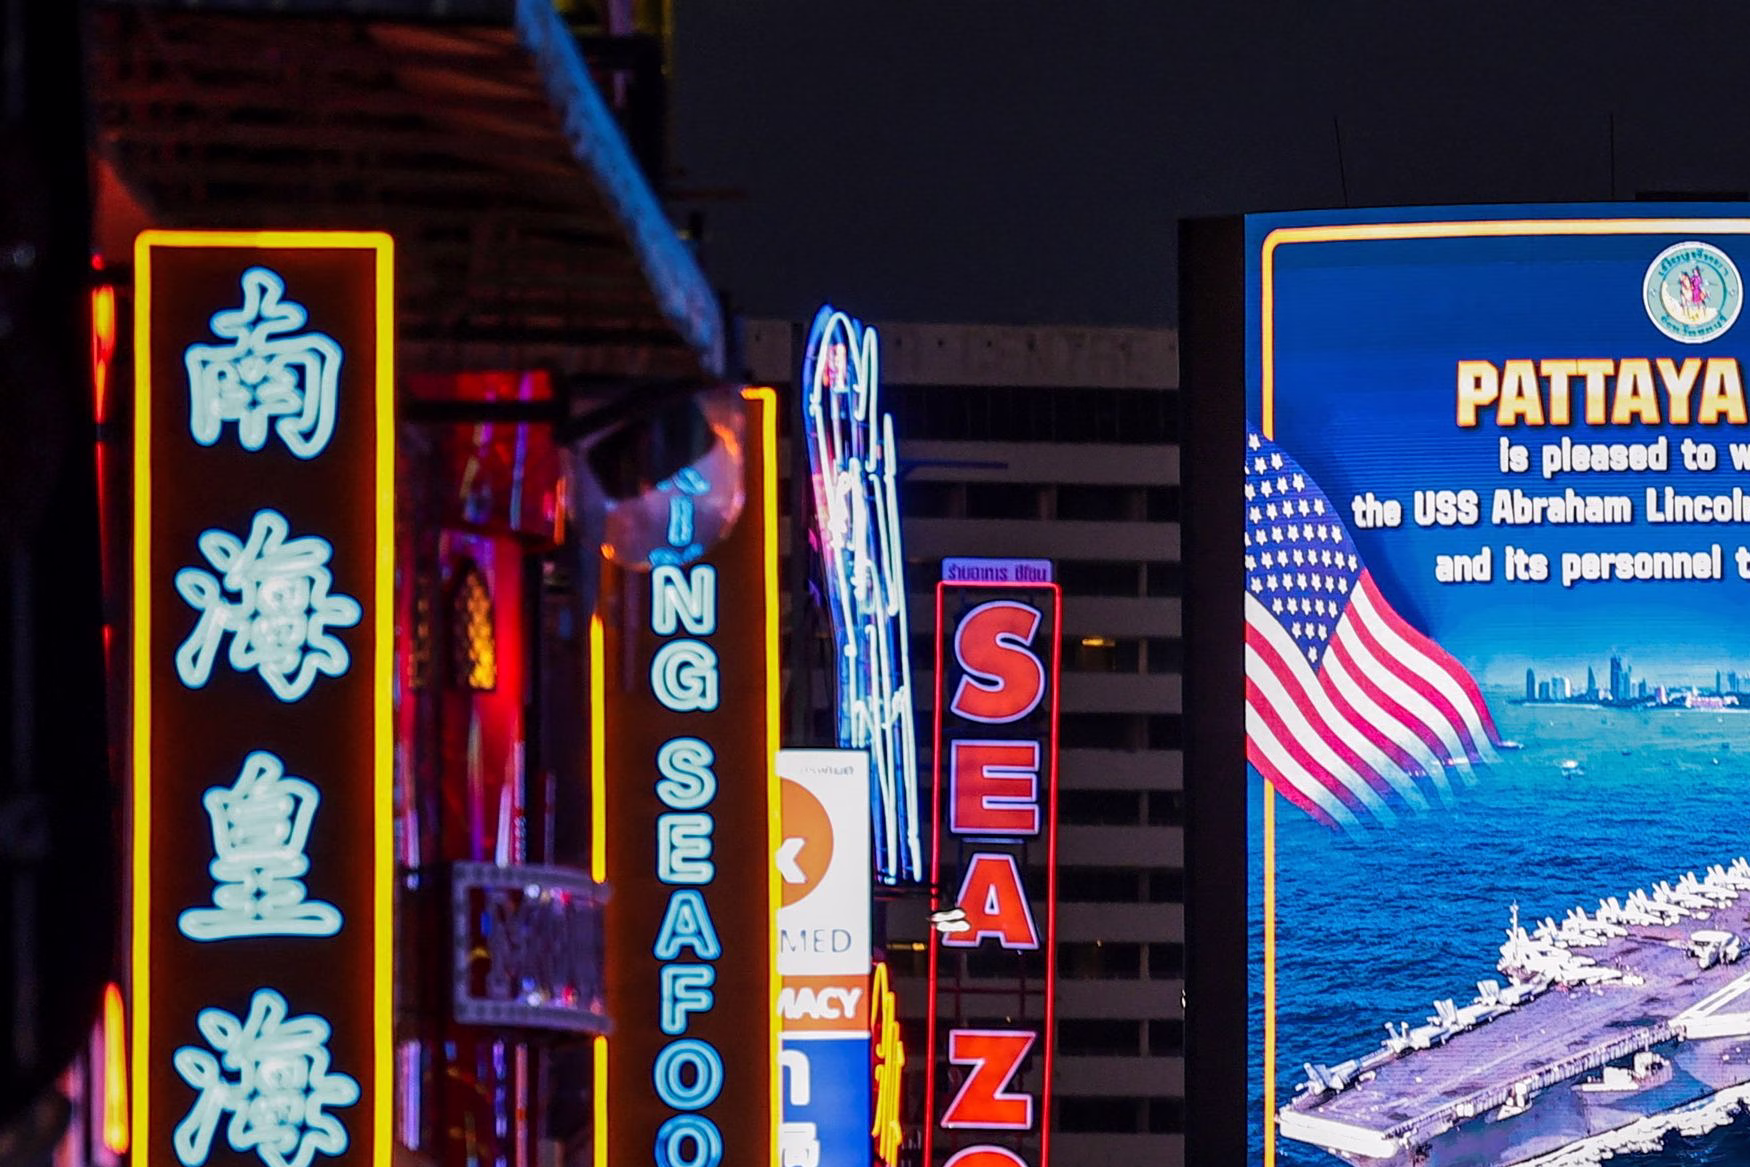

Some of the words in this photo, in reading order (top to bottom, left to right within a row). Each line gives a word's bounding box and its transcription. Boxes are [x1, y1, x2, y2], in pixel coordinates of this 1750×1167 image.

[1456, 357, 1748, 426] PATTAYA
[1499, 436, 1529, 473] is
[1542, 435, 1668, 479] pleased
[1680, 437, 1716, 471] to
[1352, 492, 1401, 528] the
[1414, 489, 1479, 526] USS
[1491, 488, 1632, 524] Abraham
[650, 465, 719, 713] ING
[1435, 546, 1491, 582] and
[1504, 545, 1548, 581] its
[1561, 543, 1721, 587] personnel
[942, 600, 1046, 950] SEA
